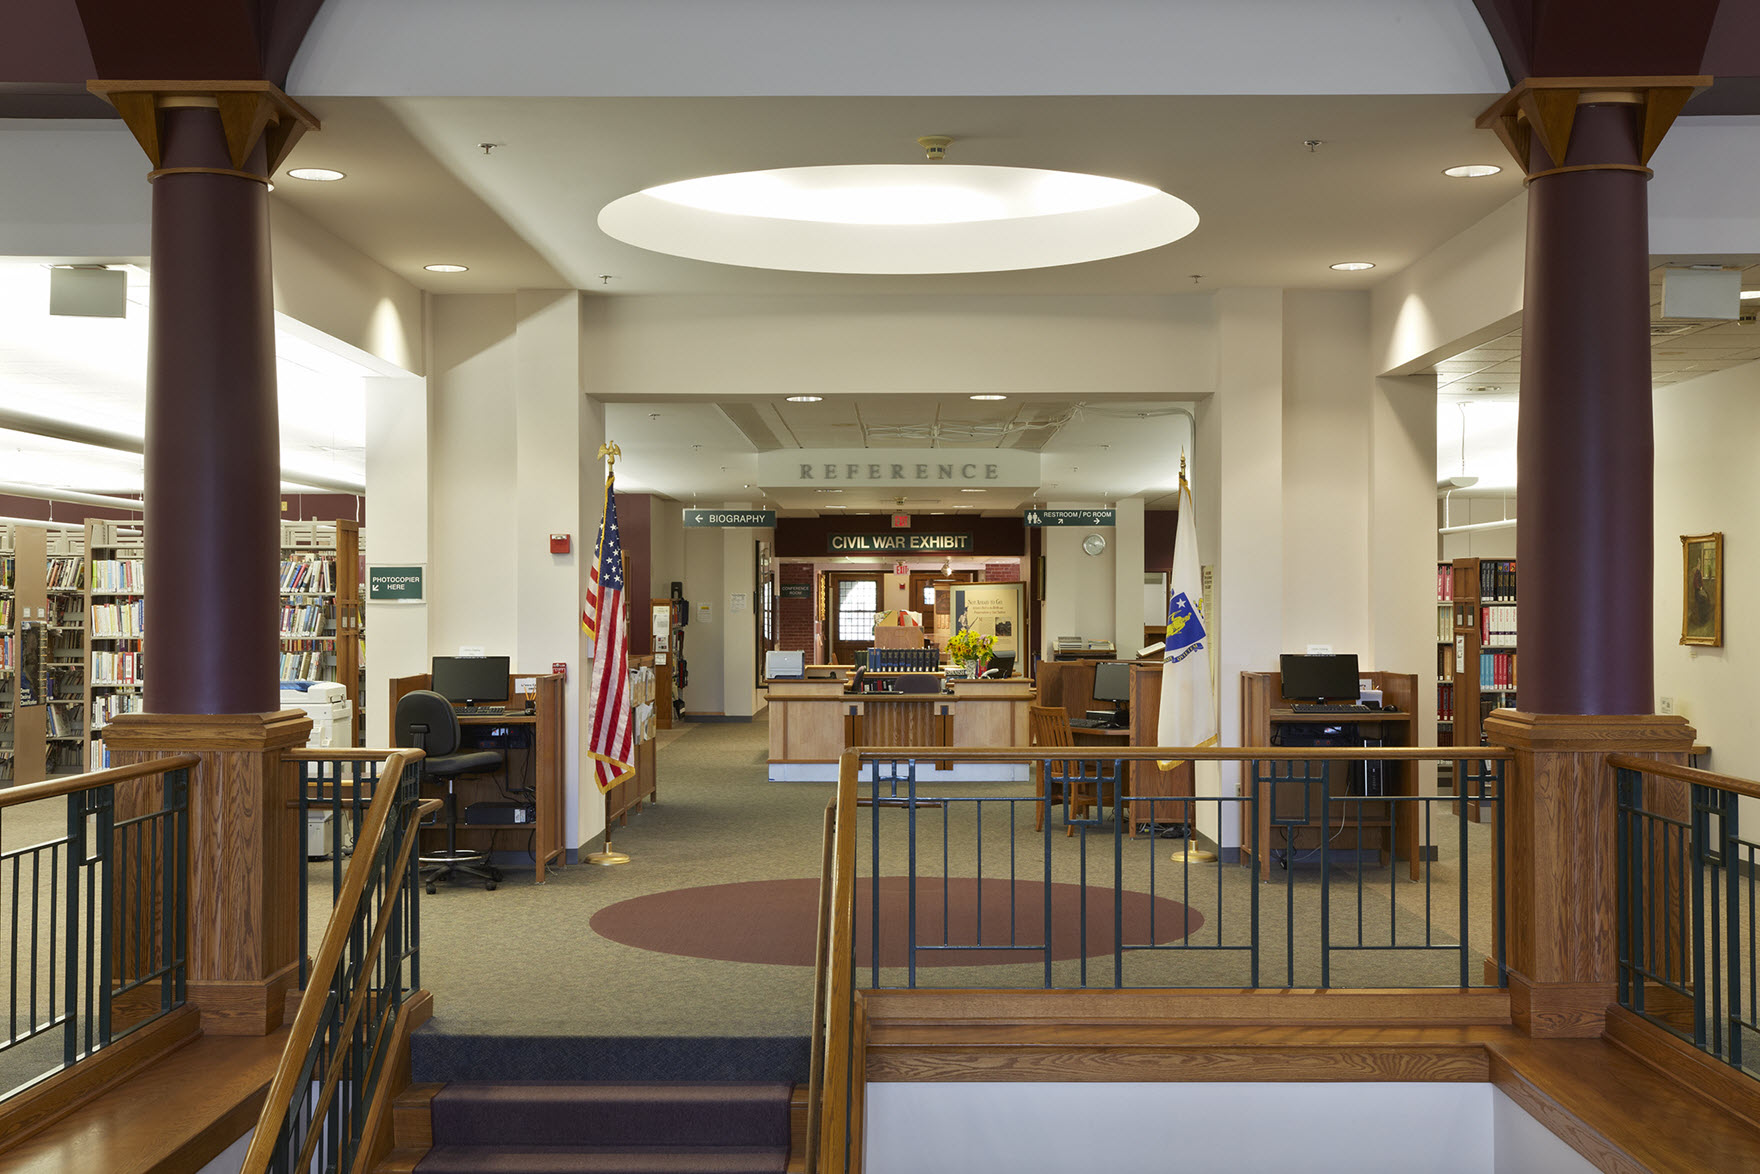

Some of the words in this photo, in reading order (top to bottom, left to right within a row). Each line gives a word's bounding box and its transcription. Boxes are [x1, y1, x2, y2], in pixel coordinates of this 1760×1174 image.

[800, 464, 999, 480] REFERENCE
[709, 514, 766, 523] BIOGRAPHY
[894, 515, 908, 527] EXIT
[832, 536, 870, 548] CIVIL
[872, 536, 906, 549] WAR
[910, 536, 967, 548] EXHIBIT
